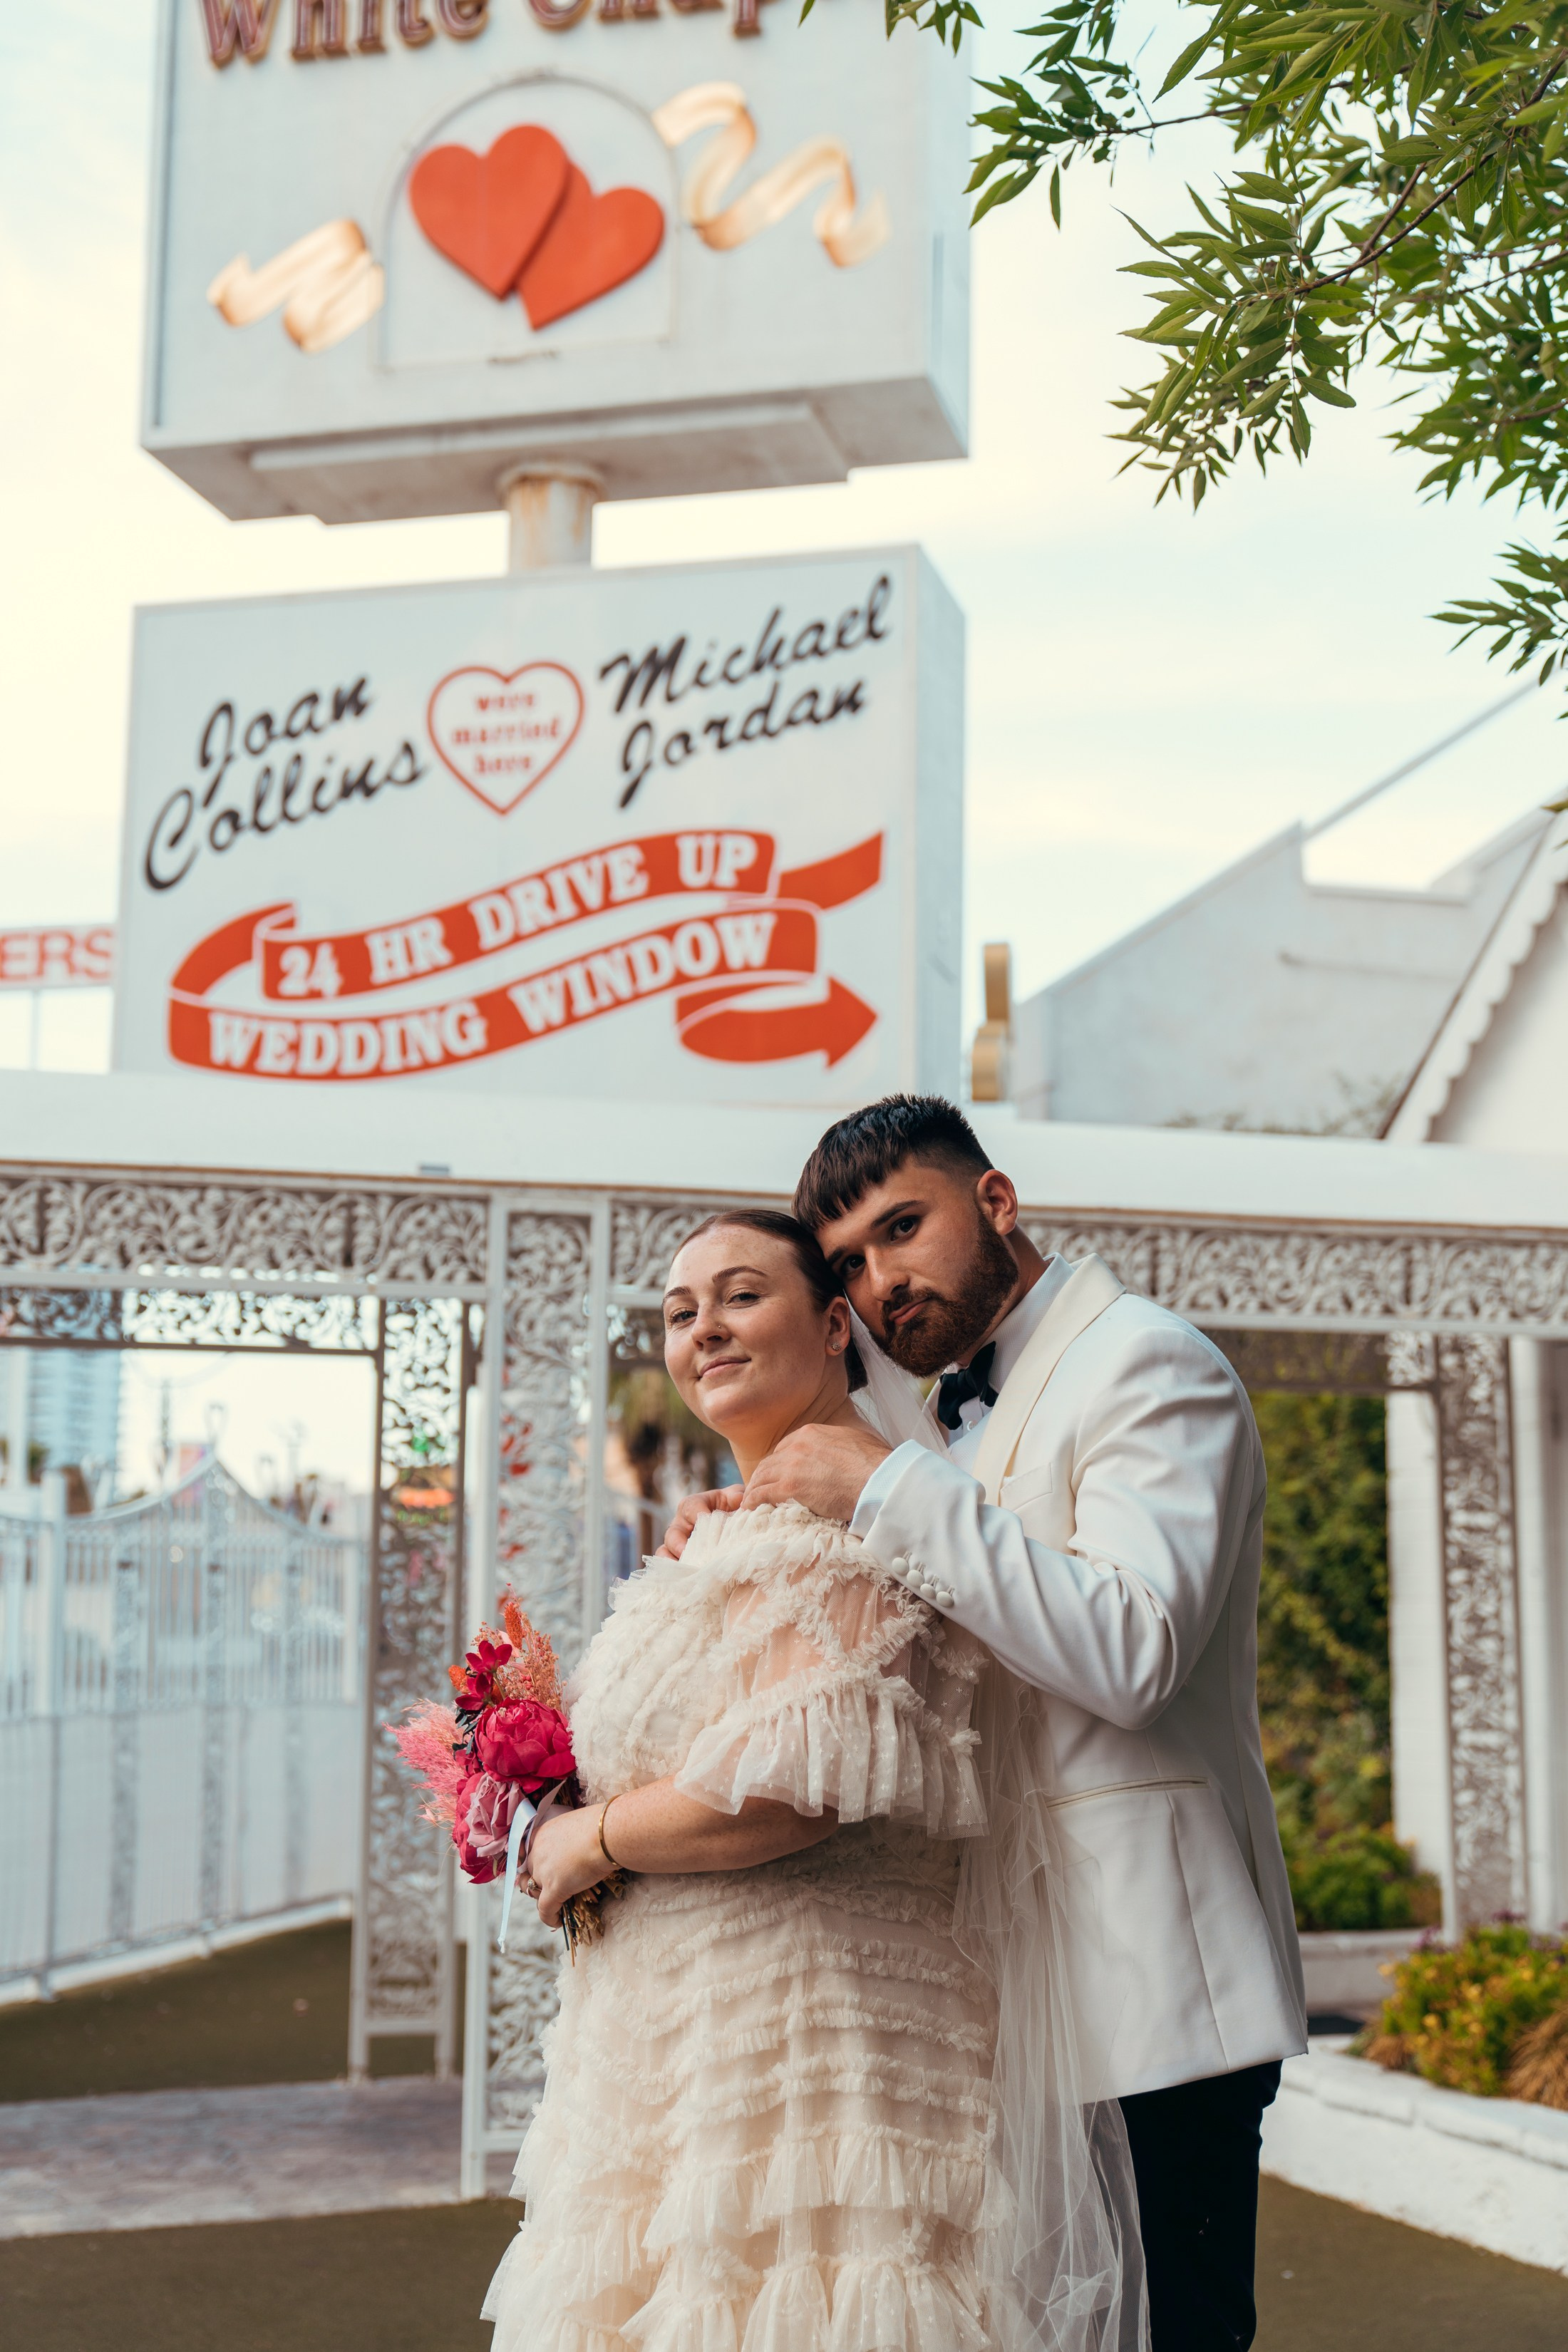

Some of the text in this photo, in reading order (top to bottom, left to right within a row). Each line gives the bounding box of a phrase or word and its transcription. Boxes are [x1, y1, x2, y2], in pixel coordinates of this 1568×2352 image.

[599, 574, 891, 713] Michael
[145, 740, 428, 891] Collins
[198, 677, 369, 810] Joan
[620, 680, 865, 808] Jordan
[277, 832, 758, 996] 24 HR DRIVE UP
[208, 912, 778, 1074] WEDDING WINDOW
